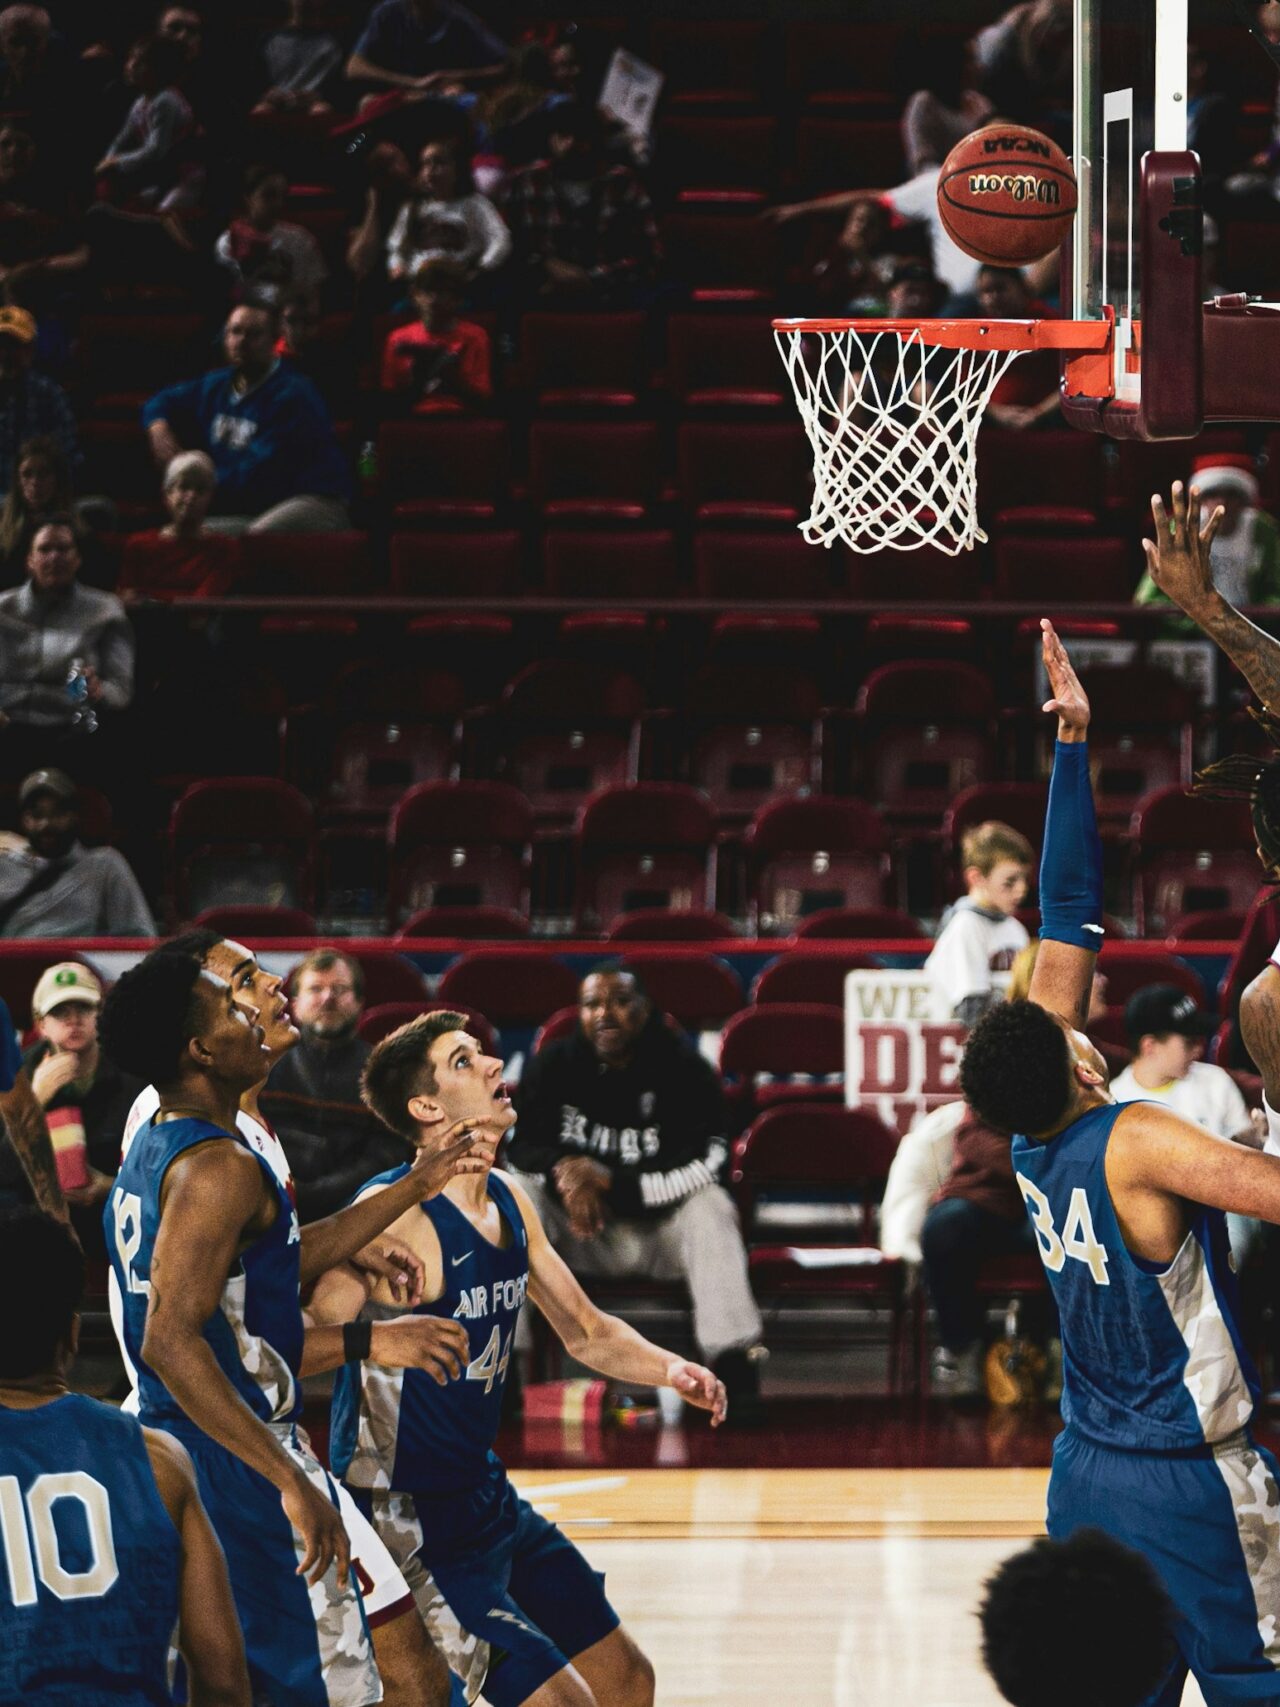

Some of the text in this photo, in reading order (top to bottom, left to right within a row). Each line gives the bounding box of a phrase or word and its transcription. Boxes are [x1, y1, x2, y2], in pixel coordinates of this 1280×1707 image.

[969, 174, 1061, 205] Wilson
[856, 983, 931, 1019] WE
[1016, 1171, 1111, 1286] 34
[453, 1285, 488, 1319] AIR
[0, 1470, 120, 1607] 10
